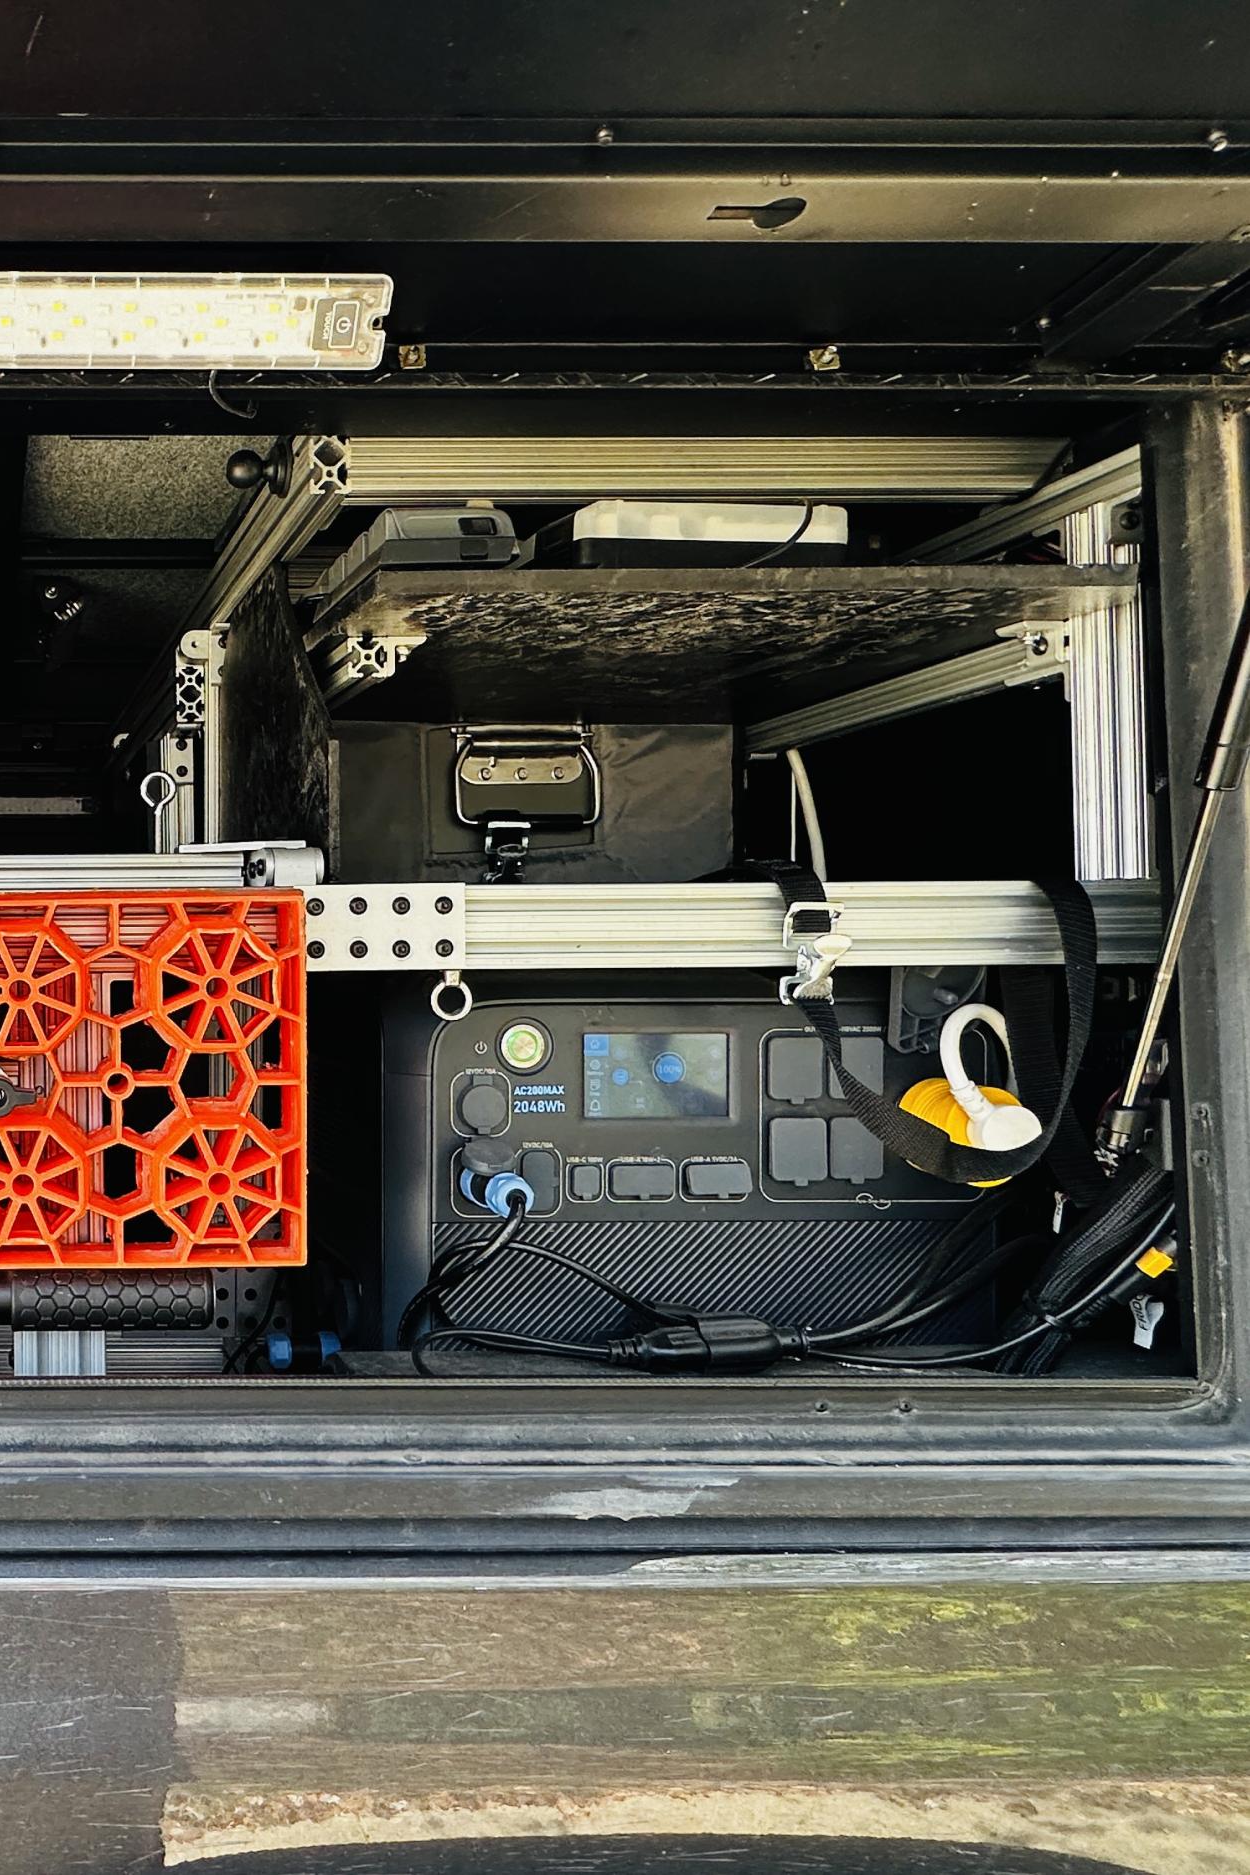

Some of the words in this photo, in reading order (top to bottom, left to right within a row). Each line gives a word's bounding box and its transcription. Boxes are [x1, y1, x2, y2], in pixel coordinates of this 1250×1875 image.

[322, 311, 332, 340] TOUCH
[657, 1064, 681, 1075] 100%
[513, 1085, 565, 1096] AC200MAX
[513, 1100, 566, 1113] 2048Wh
